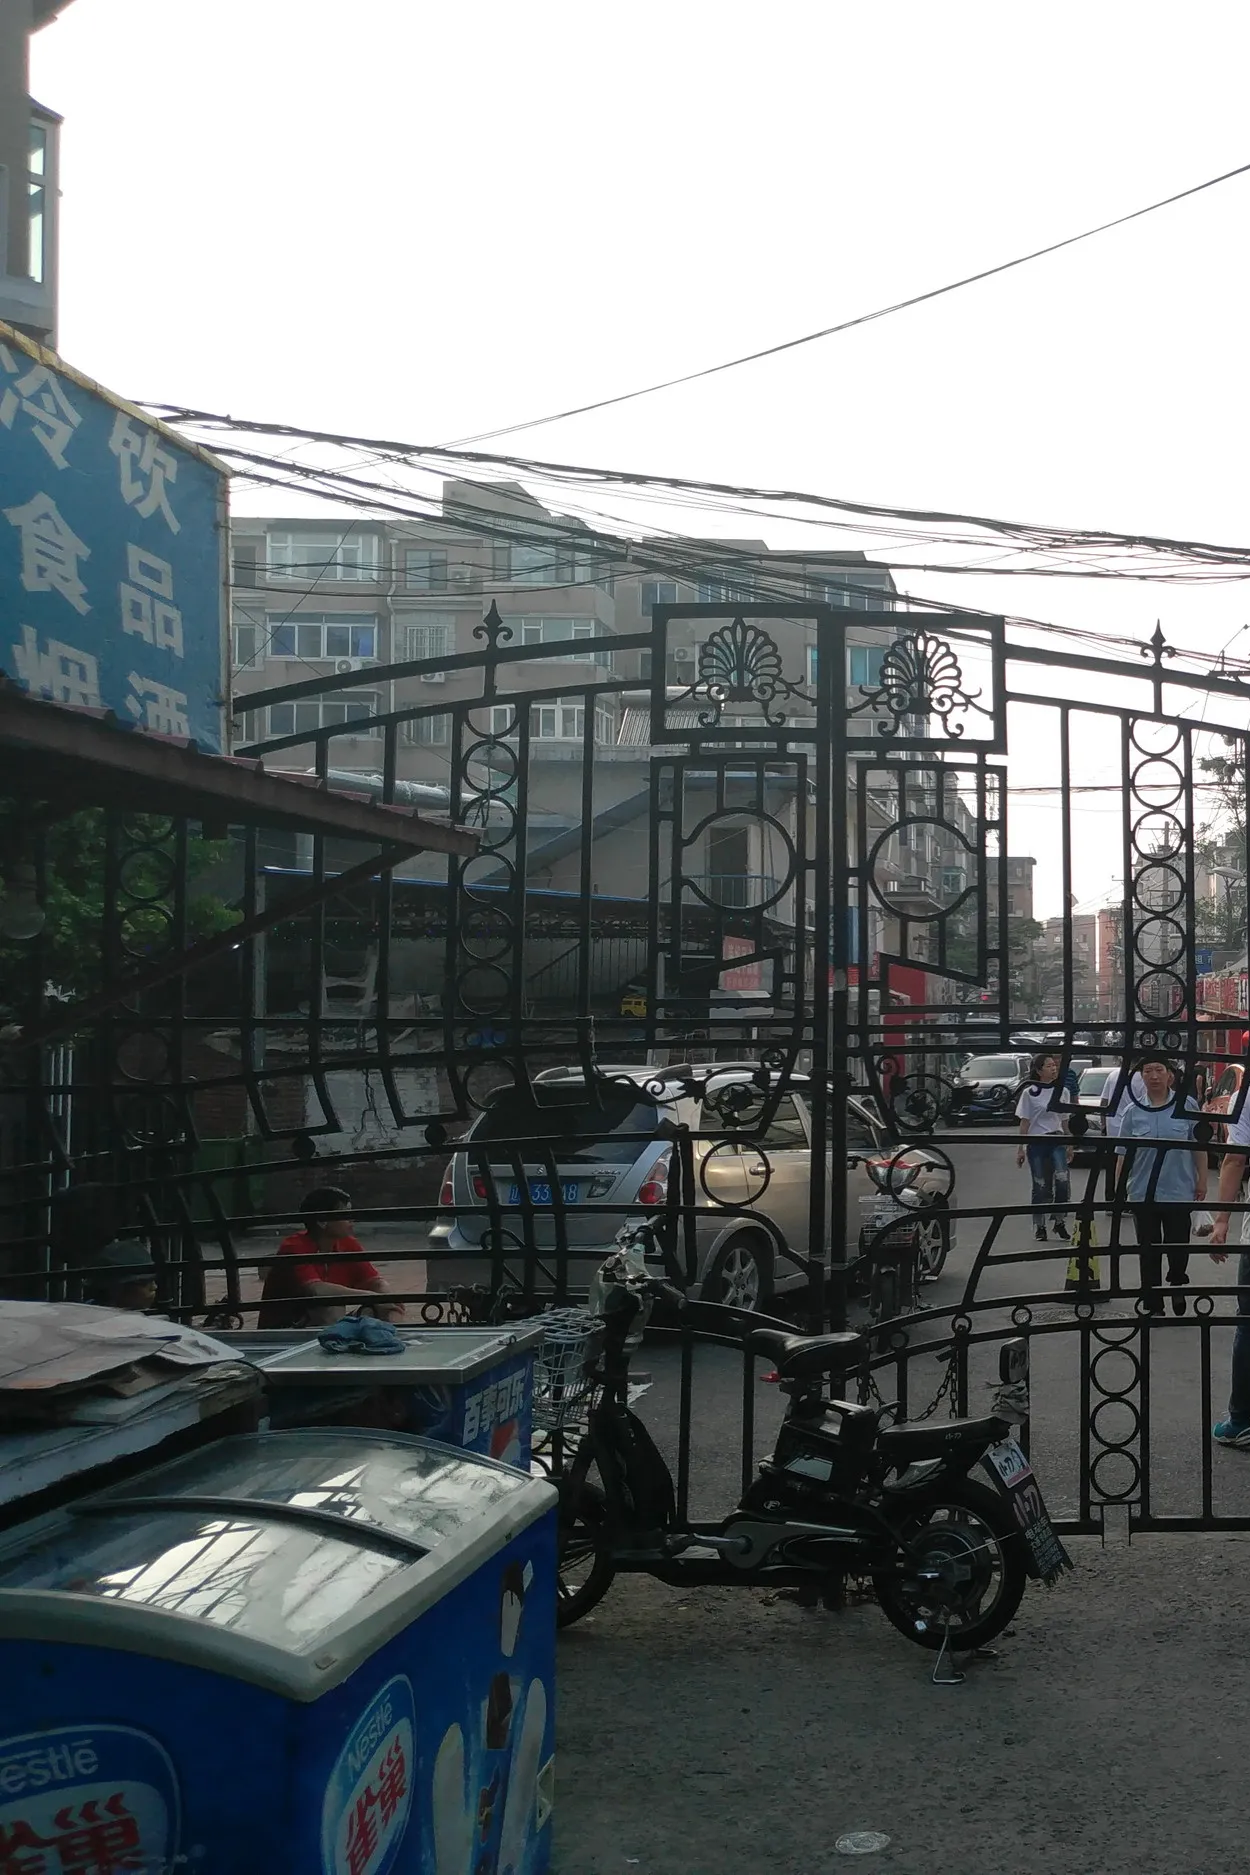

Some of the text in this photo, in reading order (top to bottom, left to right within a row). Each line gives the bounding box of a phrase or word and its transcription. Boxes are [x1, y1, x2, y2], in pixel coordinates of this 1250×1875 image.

[0, 344, 181, 536] 冷饮
[3, 491, 185, 660] 食品
[463, 1367, 527, 1447] 百事可乐
[0, 1738, 100, 1794] estlé
[347, 1693, 393, 1782] Nestlé
